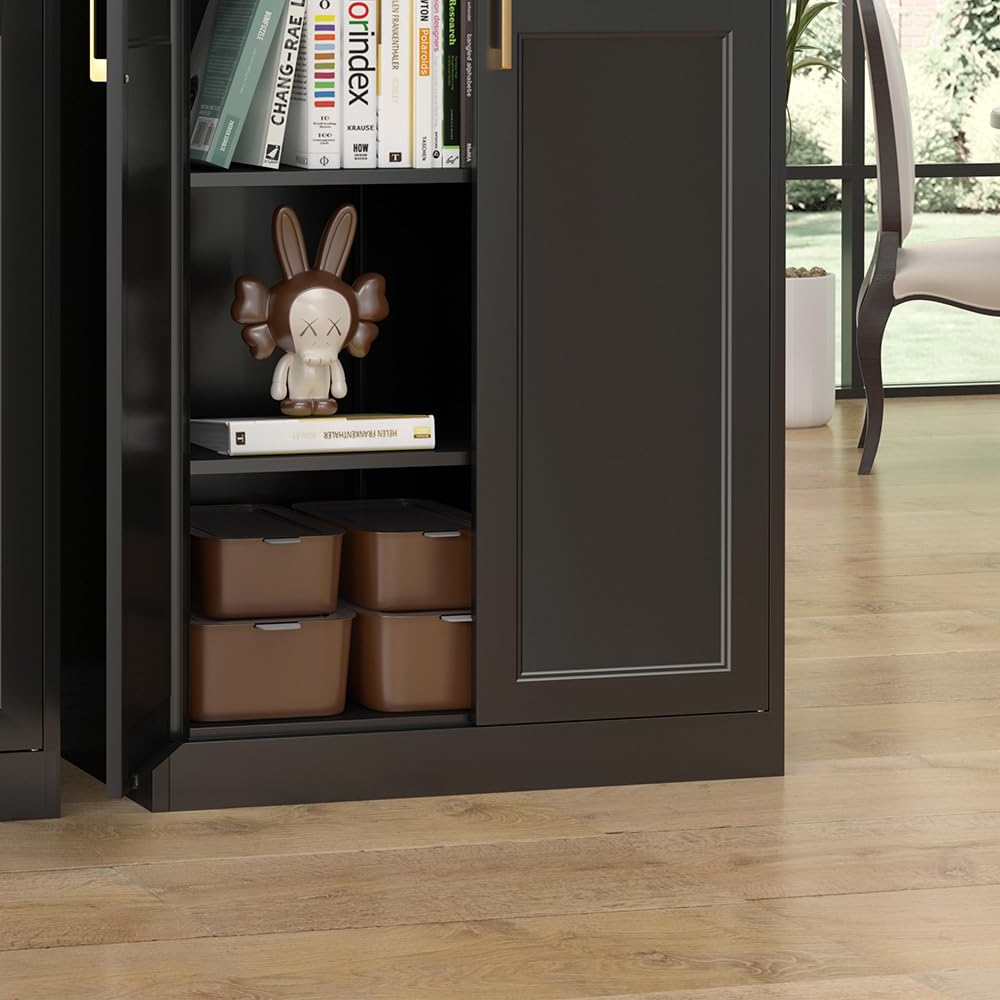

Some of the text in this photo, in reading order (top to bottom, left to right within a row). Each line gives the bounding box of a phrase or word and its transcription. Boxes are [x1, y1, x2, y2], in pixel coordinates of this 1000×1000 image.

[391, 14, 400, 70] FRANKENTHALER
[432, 15, 440, 52] designers
[270, 15, 303, 126] CHANG-RAE
[420, 29, 429, 76] Polaroids
[353, 143, 369, 153] HOW
[323, 429, 376, 440] FRANKENTHALER
[376, 429, 398, 438] HELEN
